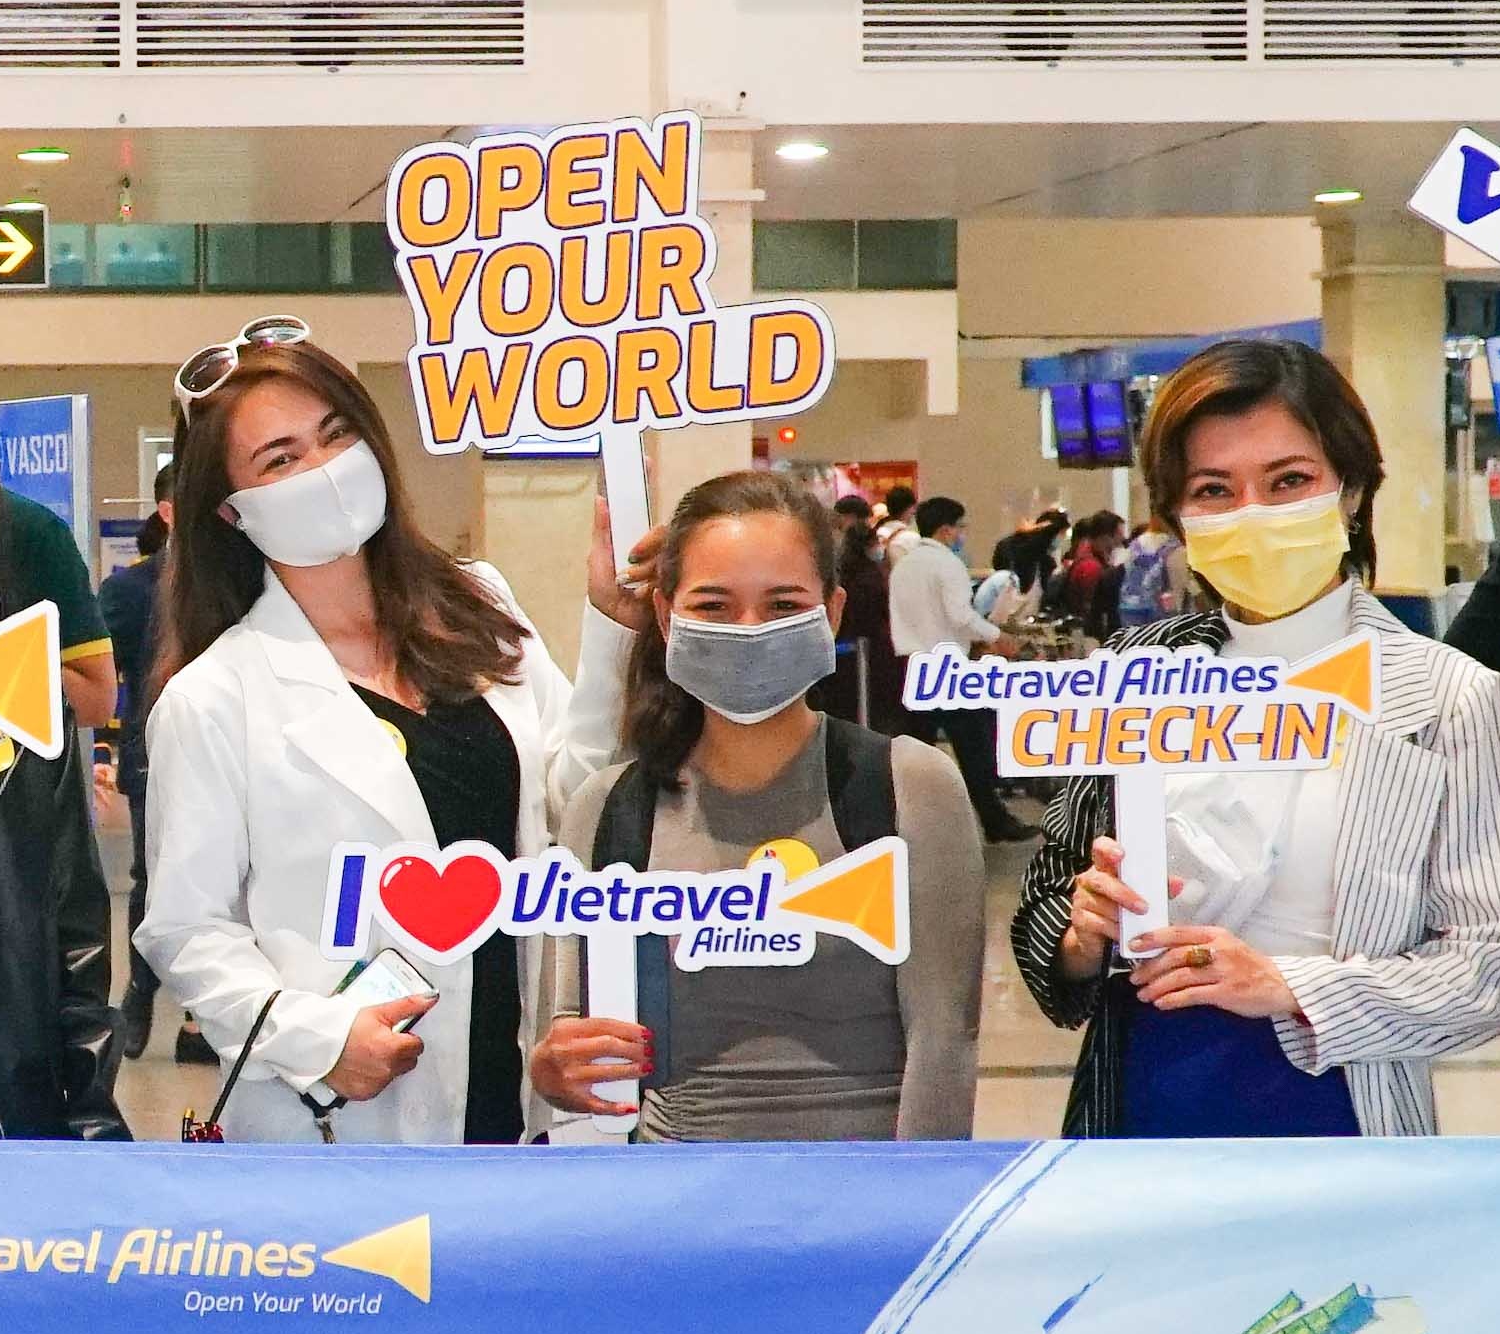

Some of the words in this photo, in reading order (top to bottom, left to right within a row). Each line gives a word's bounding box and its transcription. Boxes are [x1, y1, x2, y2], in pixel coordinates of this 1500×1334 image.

[398, 125, 693, 248] OPEN
[406, 224, 709, 345] YOUR
[419, 310, 826, 443] WORLD
[5, 433, 70, 477] VASCO
[914, 652, 1107, 702] Vietravel
[1114, 651, 1280, 701] Airlines
[1010, 702, 1342, 767] CHECK-IN
[332, 855, 368, 948] I
[510, 859, 772, 924] Vietravel
[688, 925, 803, 959] Airlines
[107, 1228, 318, 1284] Airlines
[182, 1291, 246, 1317] Open
[251, 1291, 306, 1314] Your
[310, 1292, 384, 1315] World
